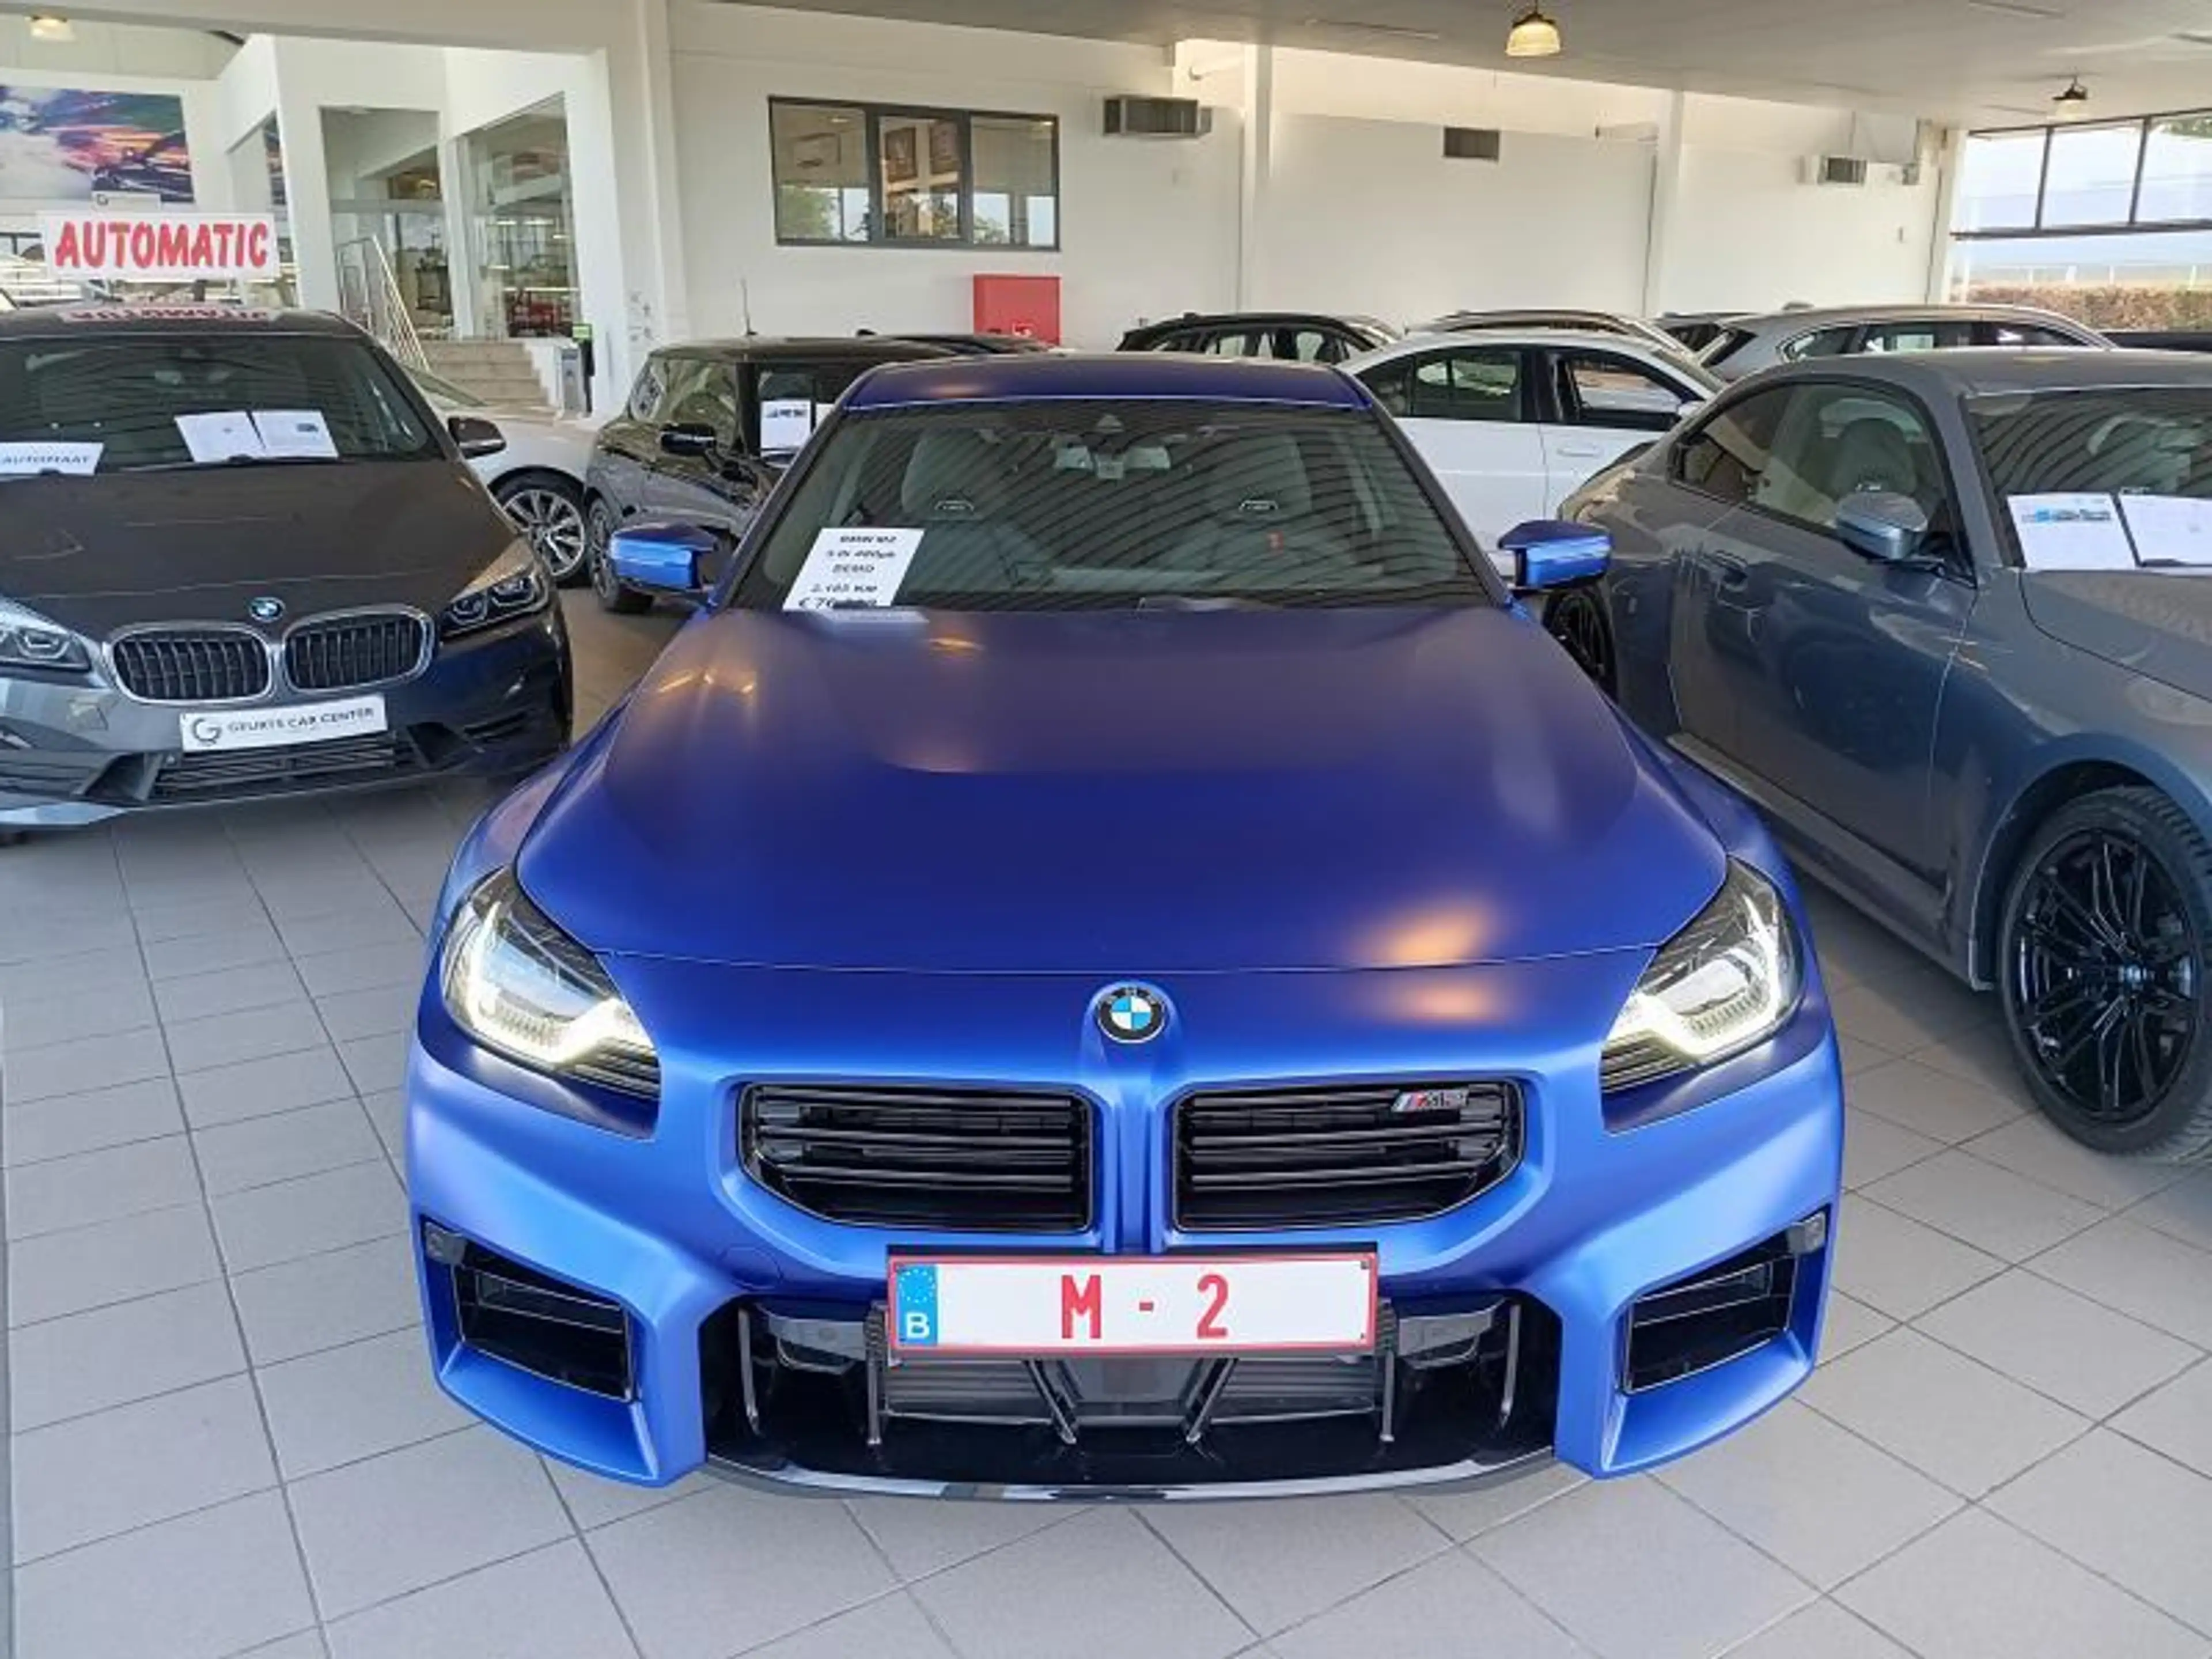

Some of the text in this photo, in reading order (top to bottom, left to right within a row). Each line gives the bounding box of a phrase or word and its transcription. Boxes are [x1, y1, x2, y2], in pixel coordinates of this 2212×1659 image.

[55, 221, 268, 268] AUTOMATIC
[287, 715, 317, 729] CAR
[1061, 1274, 1102, 1339] M
[1196, 1274, 1229, 1339] 2
[907, 1312, 930, 1338] B
